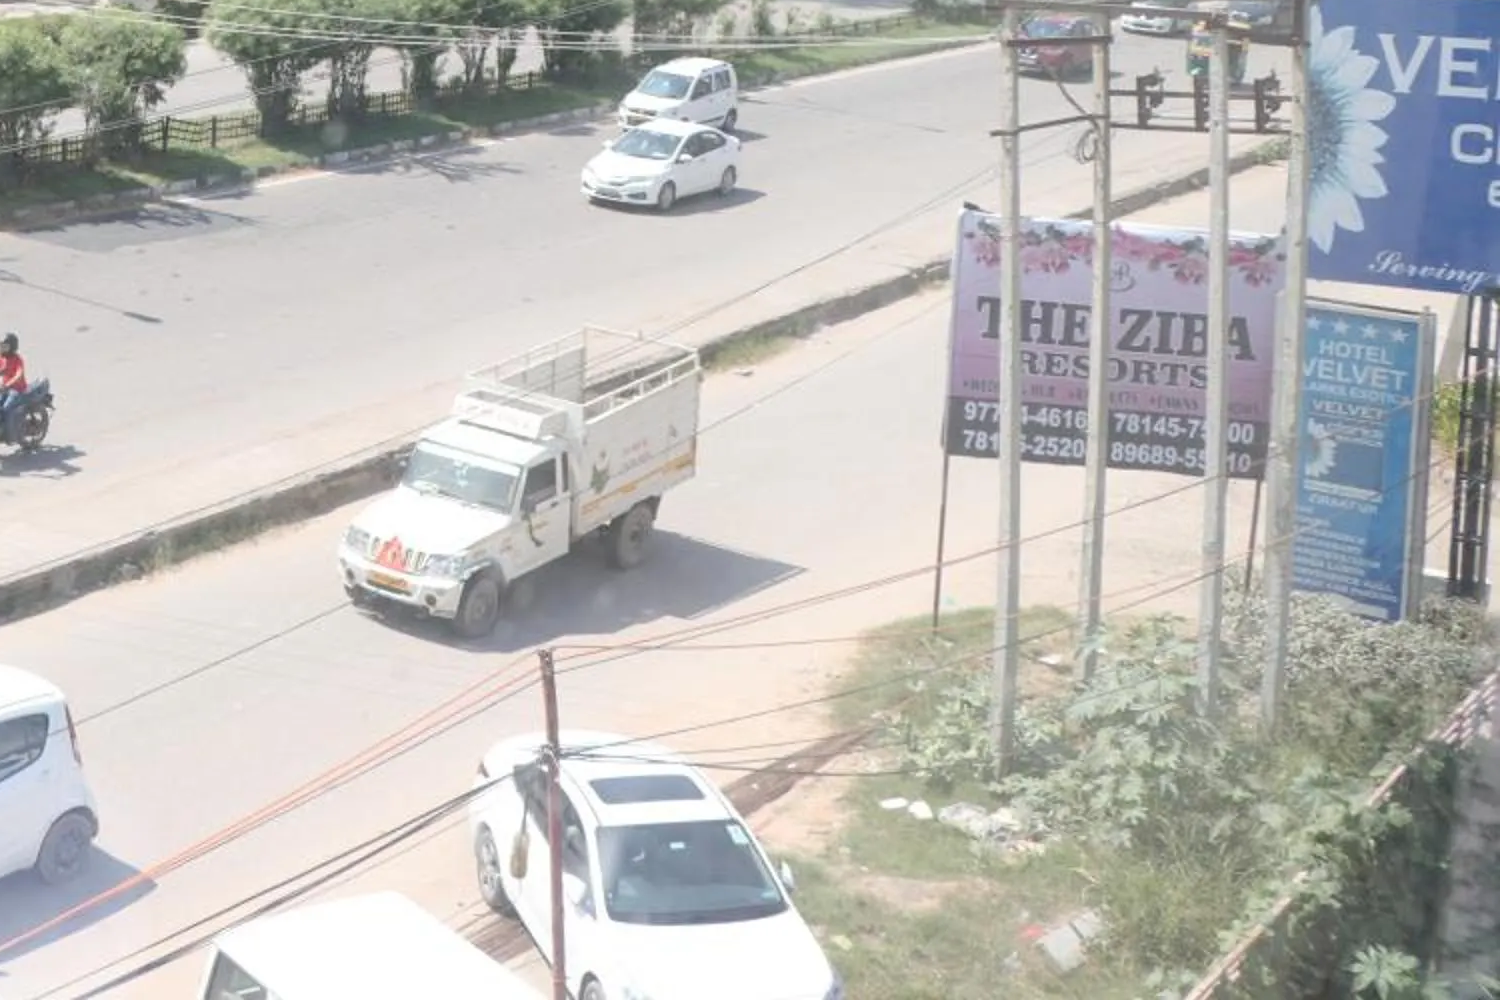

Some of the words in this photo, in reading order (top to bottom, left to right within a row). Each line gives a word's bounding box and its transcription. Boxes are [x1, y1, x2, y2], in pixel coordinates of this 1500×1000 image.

[1377, 32, 1500, 101] VE
[1368, 250, 1488, 292] Serving
[977, 296, 1092, 348] THE
[1318, 338, 1393, 366] HOTEL
[1019, 351, 1208, 390] RESORTS
[1303, 357, 1409, 391] VELVET
[1113, 412, 1255, 444] 78145-700
[1110, 441, 1252, 474] 89689-5510
